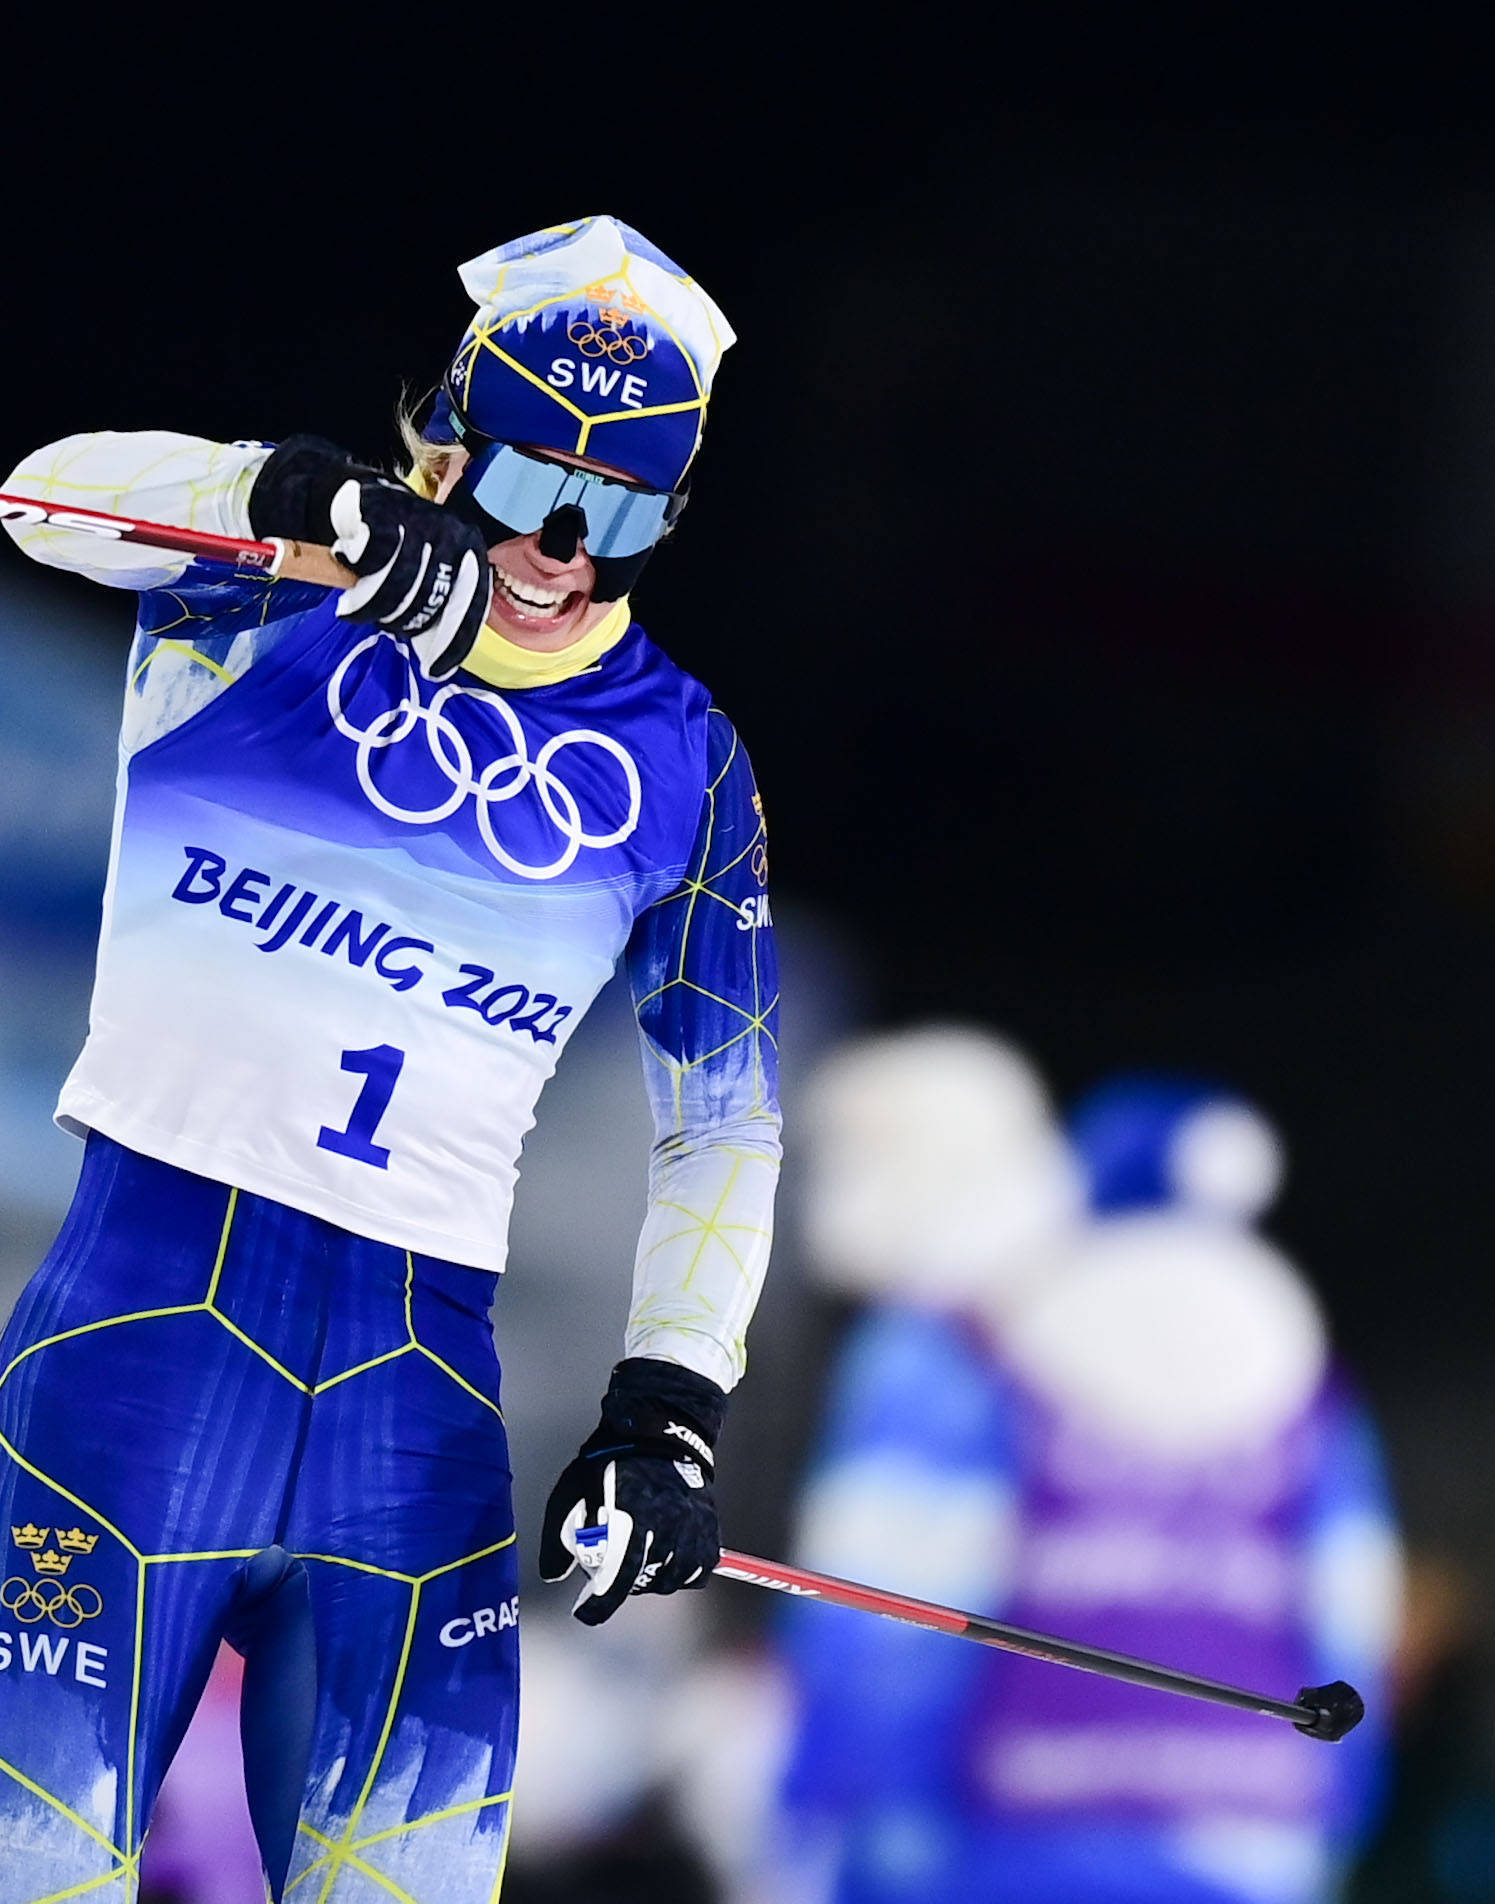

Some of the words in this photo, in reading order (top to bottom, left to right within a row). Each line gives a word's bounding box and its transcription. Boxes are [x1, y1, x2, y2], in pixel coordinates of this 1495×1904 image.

[547, 358, 648, 410] SWE
[172, 846, 435, 993] BEIJING
[442, 963, 572, 1046] 2022
[736, 893, 774, 932] SW
[316, 1044, 406, 1171] 1
